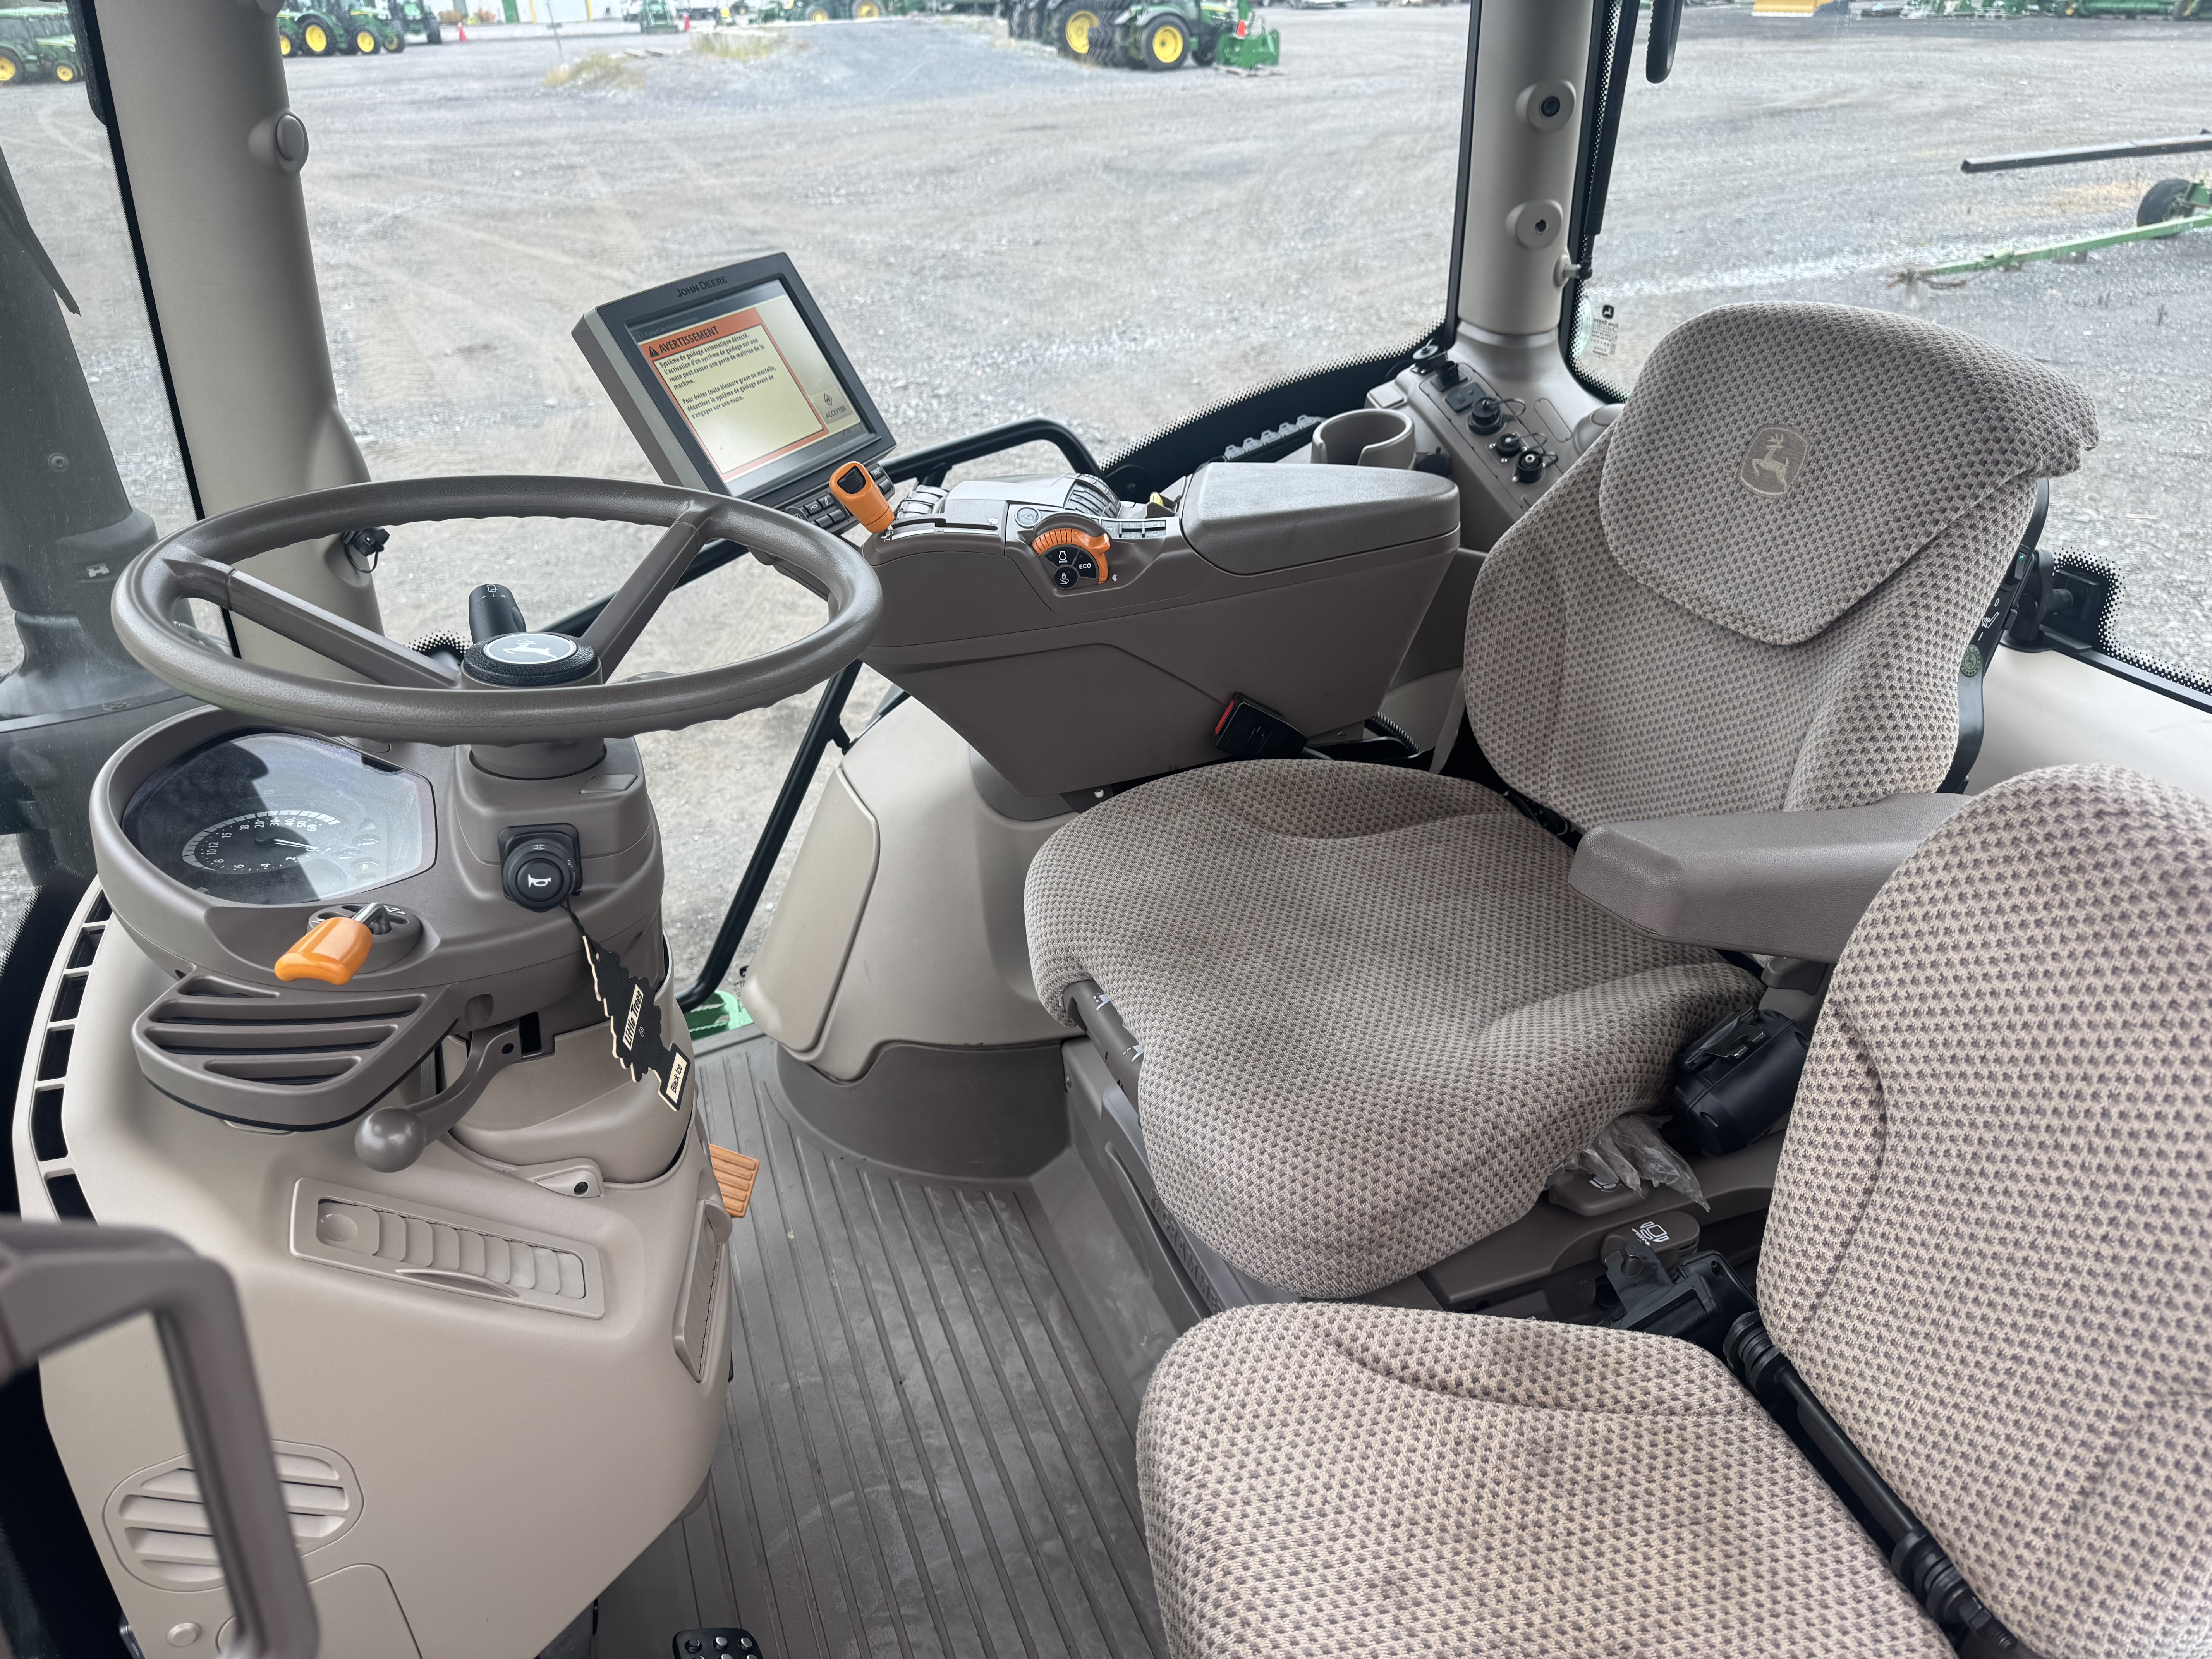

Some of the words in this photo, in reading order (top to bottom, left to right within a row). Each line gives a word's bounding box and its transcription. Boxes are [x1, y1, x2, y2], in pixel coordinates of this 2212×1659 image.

[677, 284, 700, 297] JOHN
[698, 276, 728, 290] DEERE
[659, 326, 719, 353] AVERTISSEMENT
[659, 357, 680, 368] Système
[686, 349, 704, 360] guidage
[704, 339, 732, 353] automatique
[732, 333, 750, 342] détecté.
[664, 362, 691, 375] L'activation
[702, 352, 720, 362] système
[726, 344, 742, 354] guidage
[683, 370, 694, 379] peut
[694, 365, 708, 373] causer
[718, 357, 730, 366] perte
[736, 349, 754, 359] maîtrise
[674, 379, 695, 390] machine.
[687, 399, 710, 412] désactiver
[716, 390, 734, 401] système
[740, 382, 756, 393] guidage
[757, 376, 768, 385] avant
[694, 392, 708, 400] éviter
[720, 380, 739, 390] blessure
[739, 375, 751, 384] grave
[757, 366, 776, 376] mortelle,
[692, 407, 713, 419] s'engager
[825, 406, 847, 418] ACCEPTER
[624, 1017, 635, 1047] Little
[631, 990, 642, 1017] Trees
